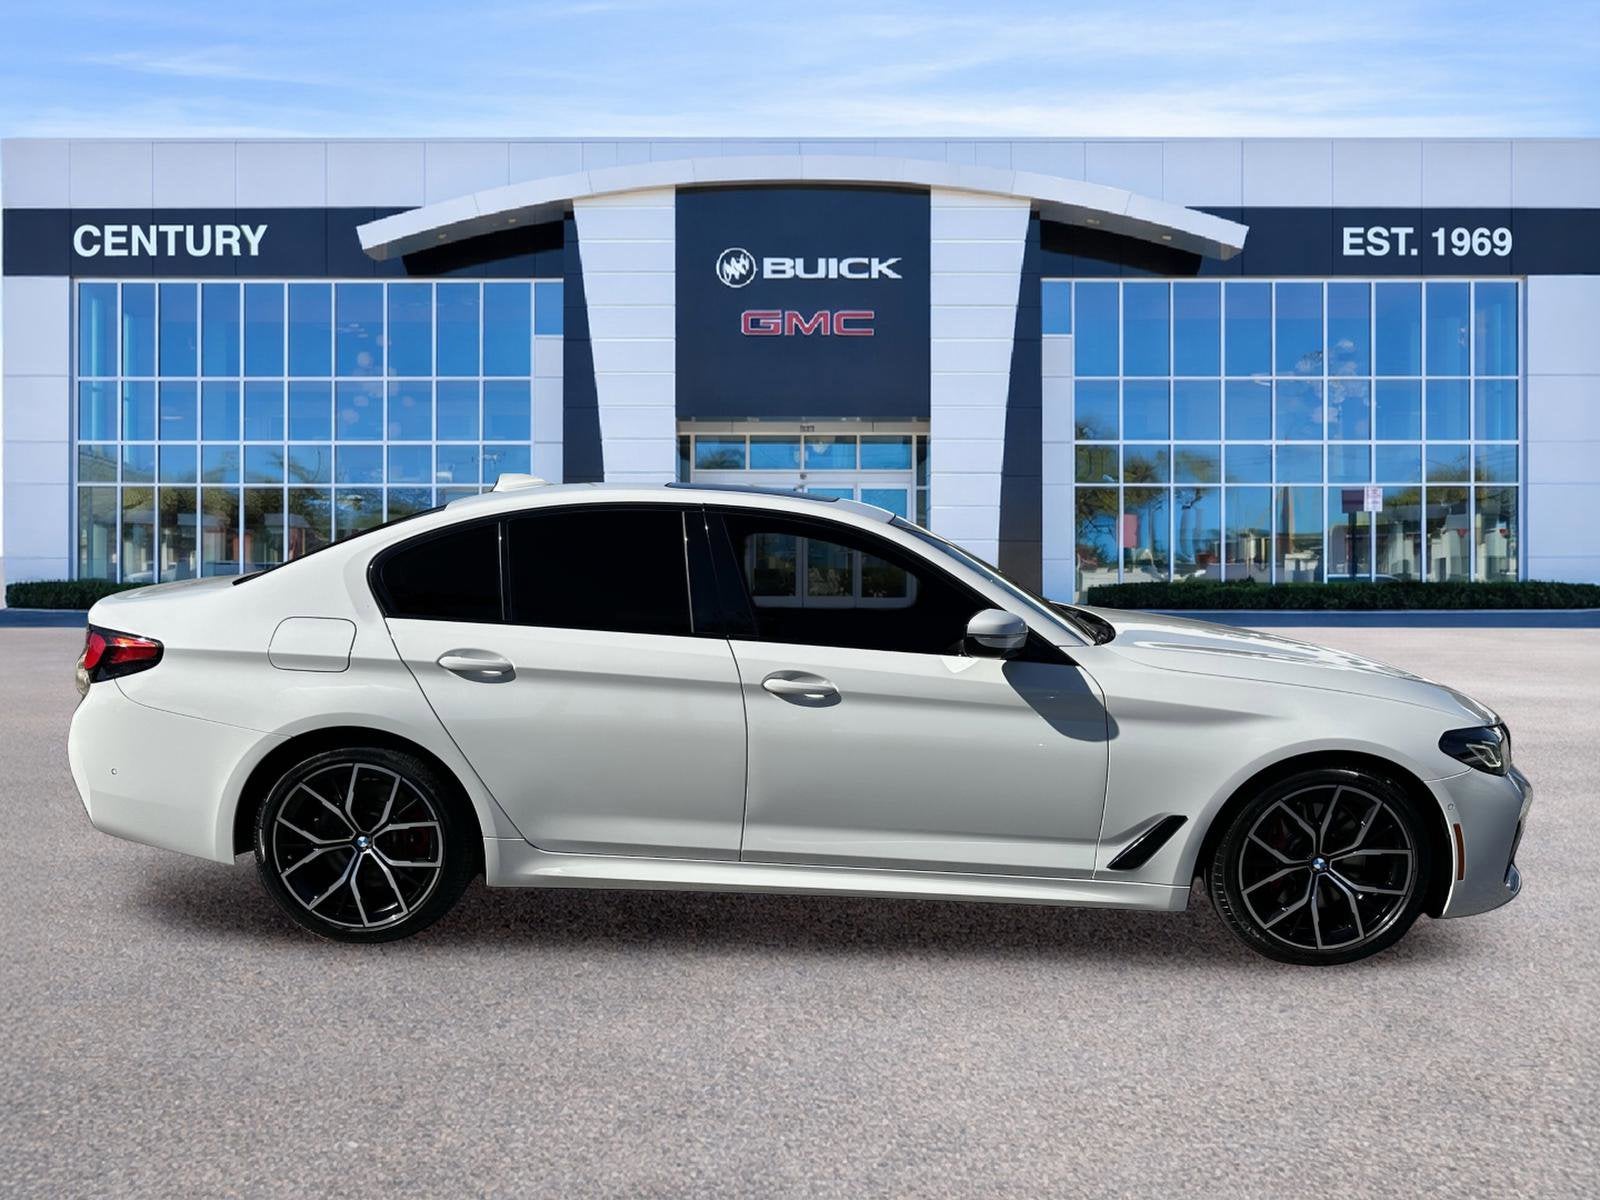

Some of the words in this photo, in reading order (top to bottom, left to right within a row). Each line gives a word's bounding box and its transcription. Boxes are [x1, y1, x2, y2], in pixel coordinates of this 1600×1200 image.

[73, 224, 268, 257] CENTURY
[1342, 226, 1418, 256] EST.
[1431, 227, 1513, 256] 1969
[762, 257, 903, 279] BUICK
[741, 310, 875, 336] GMC
